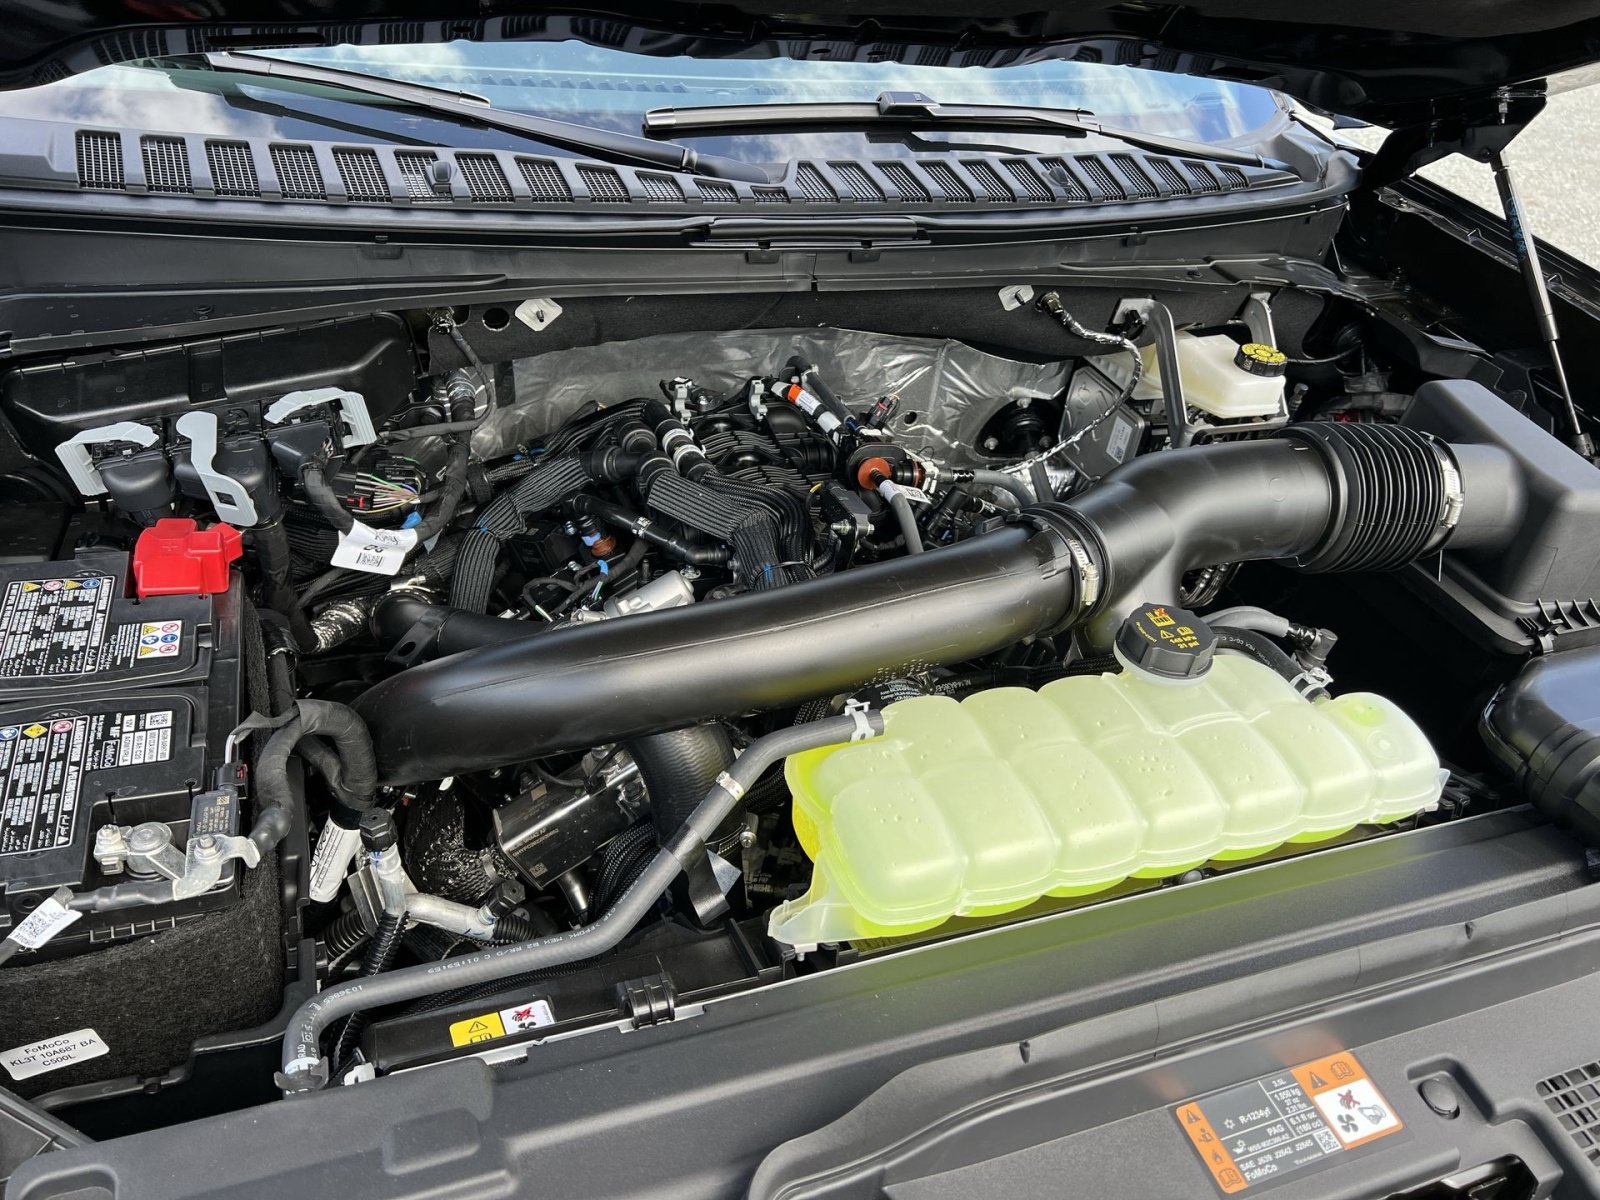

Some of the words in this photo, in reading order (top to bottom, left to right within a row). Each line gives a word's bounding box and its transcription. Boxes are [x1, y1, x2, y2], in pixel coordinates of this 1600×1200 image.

[9, 1055, 37, 1067] KL3T
[40, 1044, 78, 1059] 10A687
[79, 1038, 97, 1048] BA
[24, 1039, 70, 1055] FoMoCo
[42, 1054, 76, 1067] C500L
[1238, 1107, 1272, 1125] R-1234yf
[1266, 1124, 1285, 1136] PAG
[1239, 1160, 1256, 1171] SAE
[1244, 1164, 1278, 1180] FoMoCo
